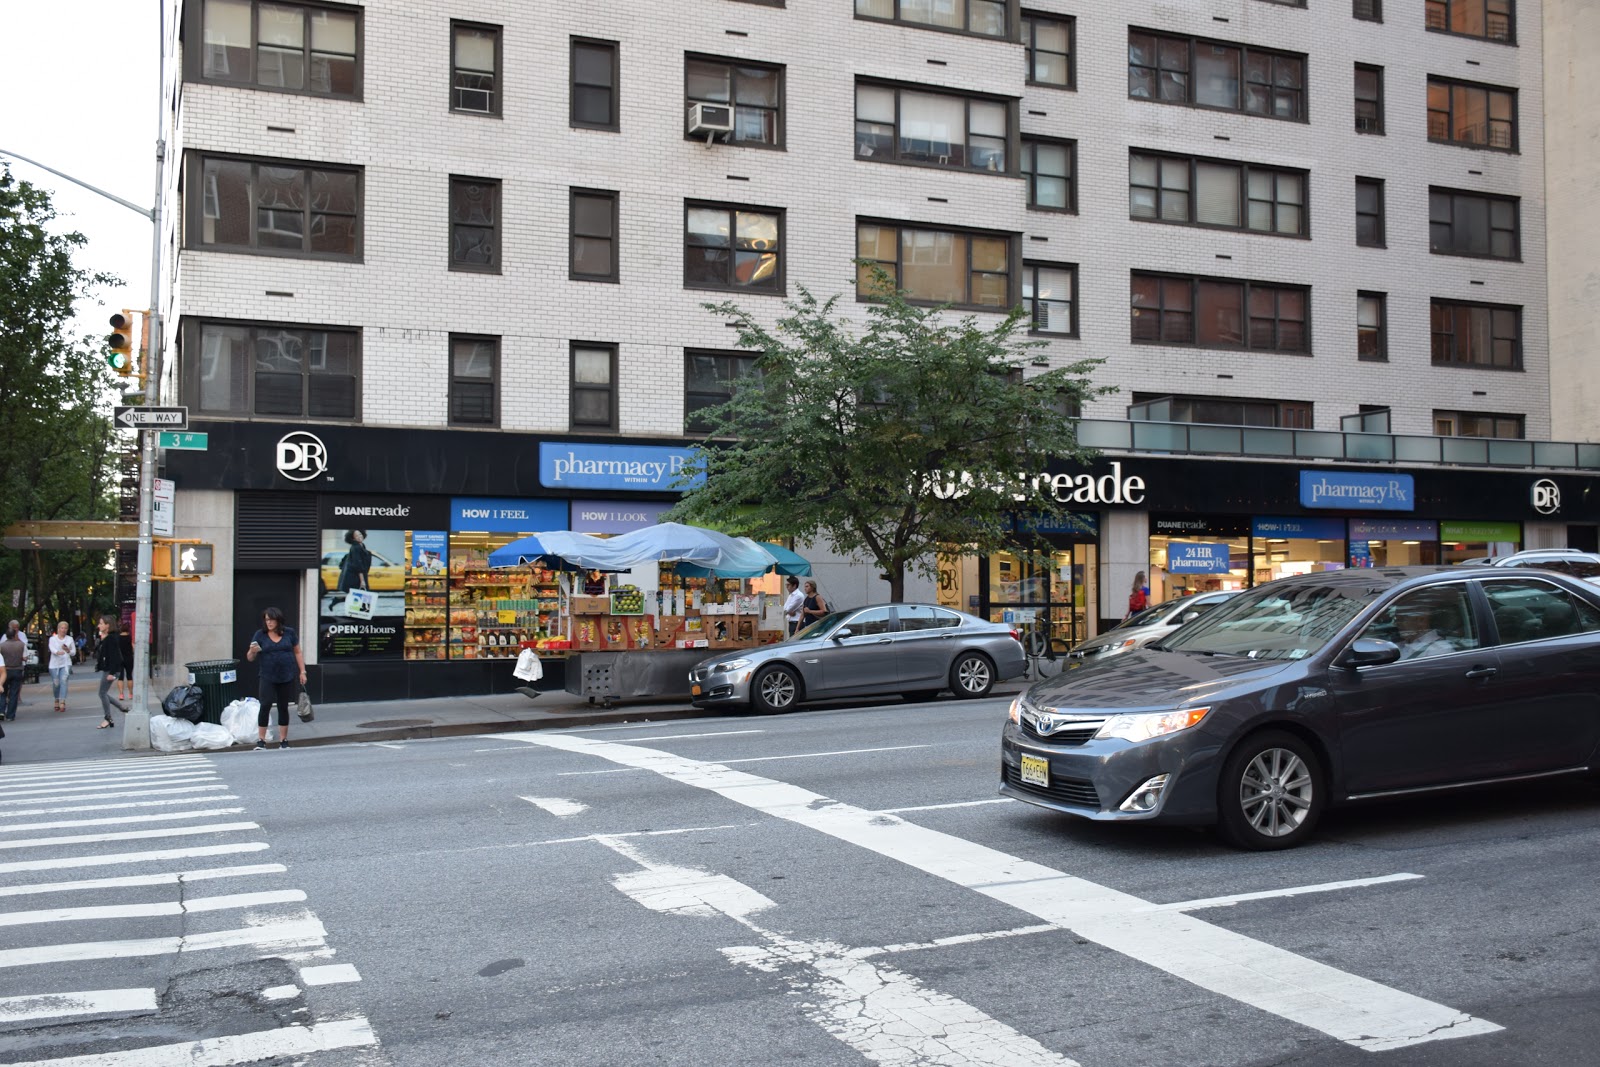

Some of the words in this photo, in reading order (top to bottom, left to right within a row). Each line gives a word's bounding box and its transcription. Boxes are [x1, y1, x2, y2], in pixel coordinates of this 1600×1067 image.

[125, 413, 146, 422] ONE
[156, 413, 178, 422] WAY
[172, 434, 181, 447] 3
[185, 434, 193, 442] AV
[276, 442, 328, 472] DR
[553, 452, 668, 484] pharmacy
[1312, 479, 1388, 504] pharmacy
[1533, 487, 1561, 508] DR
[462, 508, 490, 519] HOW
[493, 510, 498, 519] I
[500, 509, 529, 520] FEEL
[581, 511, 607, 521] HOW
[610, 512, 614, 521] I
[616, 512, 647, 522] LOOK
[1258, 523, 1277, 531] HOW
[1185, 547, 1196, 558] 24
[1197, 547, 1213, 558] HR
[1171, 556, 1215, 570] pharmacy
[329, 624, 358, 634] OPEN
[370, 624, 396, 634] hours
